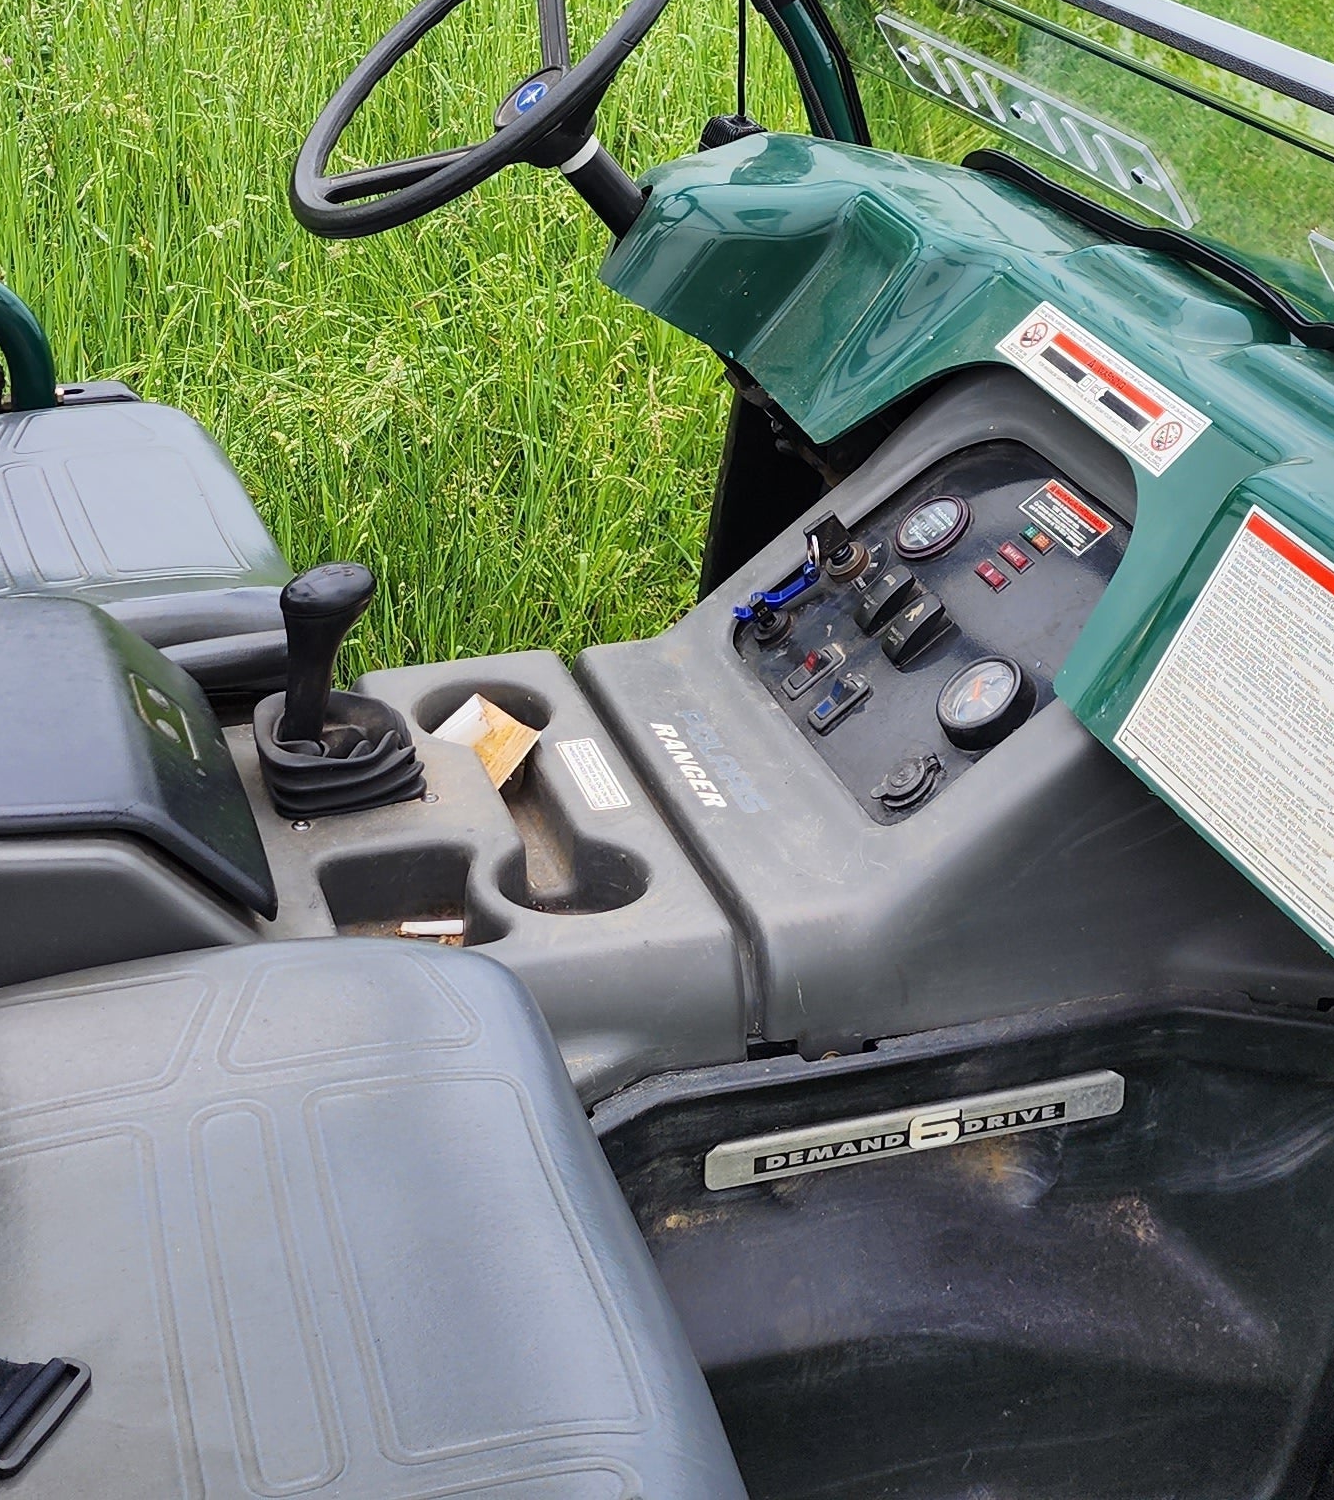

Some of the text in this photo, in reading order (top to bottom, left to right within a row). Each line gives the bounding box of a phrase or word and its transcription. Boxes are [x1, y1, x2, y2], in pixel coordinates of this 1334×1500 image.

[650, 723, 727, 808] RANGER
[680, 710, 771, 813] POLARIS
[765, 1105, 1058, 1171] DEMAND 6 DRIVE
